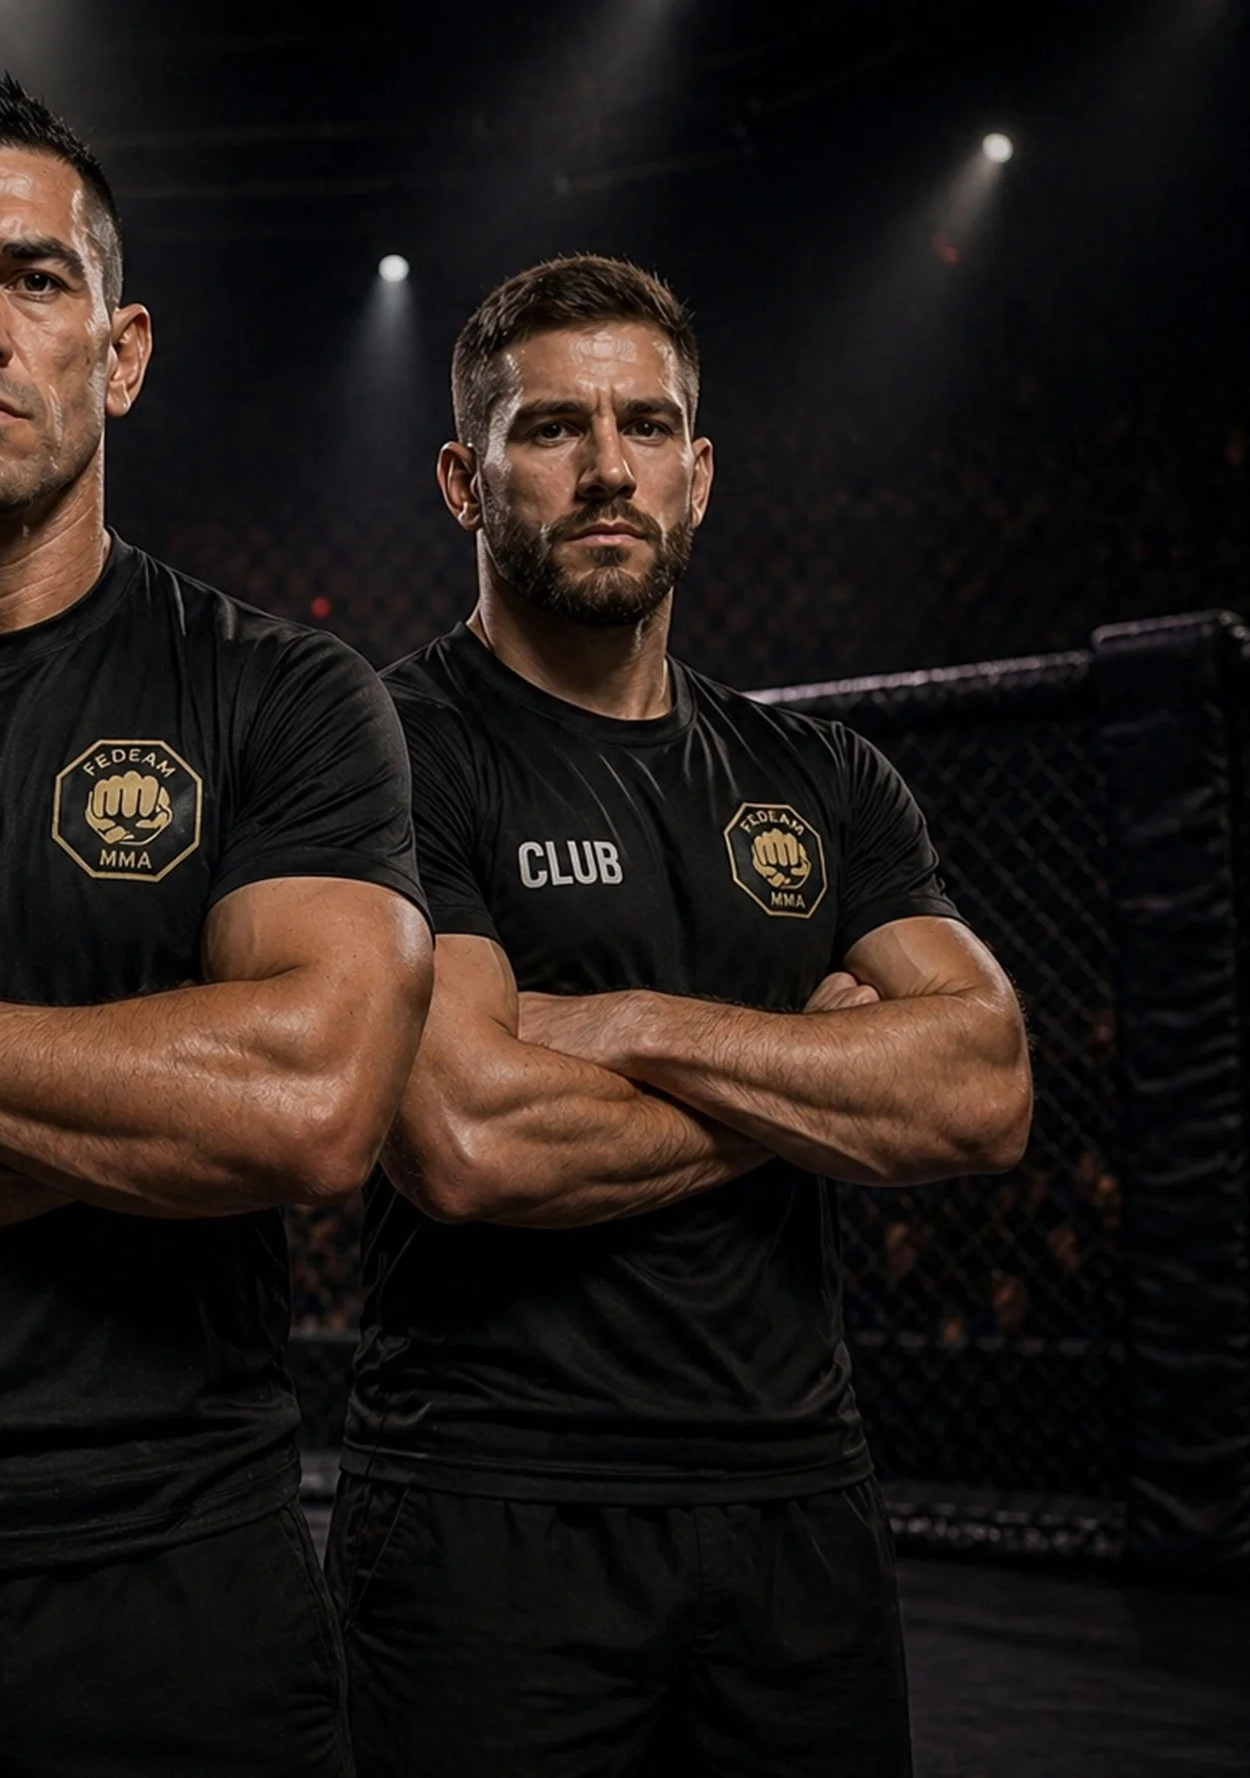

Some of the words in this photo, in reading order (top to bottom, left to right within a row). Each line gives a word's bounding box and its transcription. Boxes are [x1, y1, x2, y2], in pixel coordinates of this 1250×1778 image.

[82, 748, 176, 778] FEDEAM
[99, 849, 152, 869] MMA
[518, 840, 623, 888] CLUB
[770, 891, 806, 909] MMA
